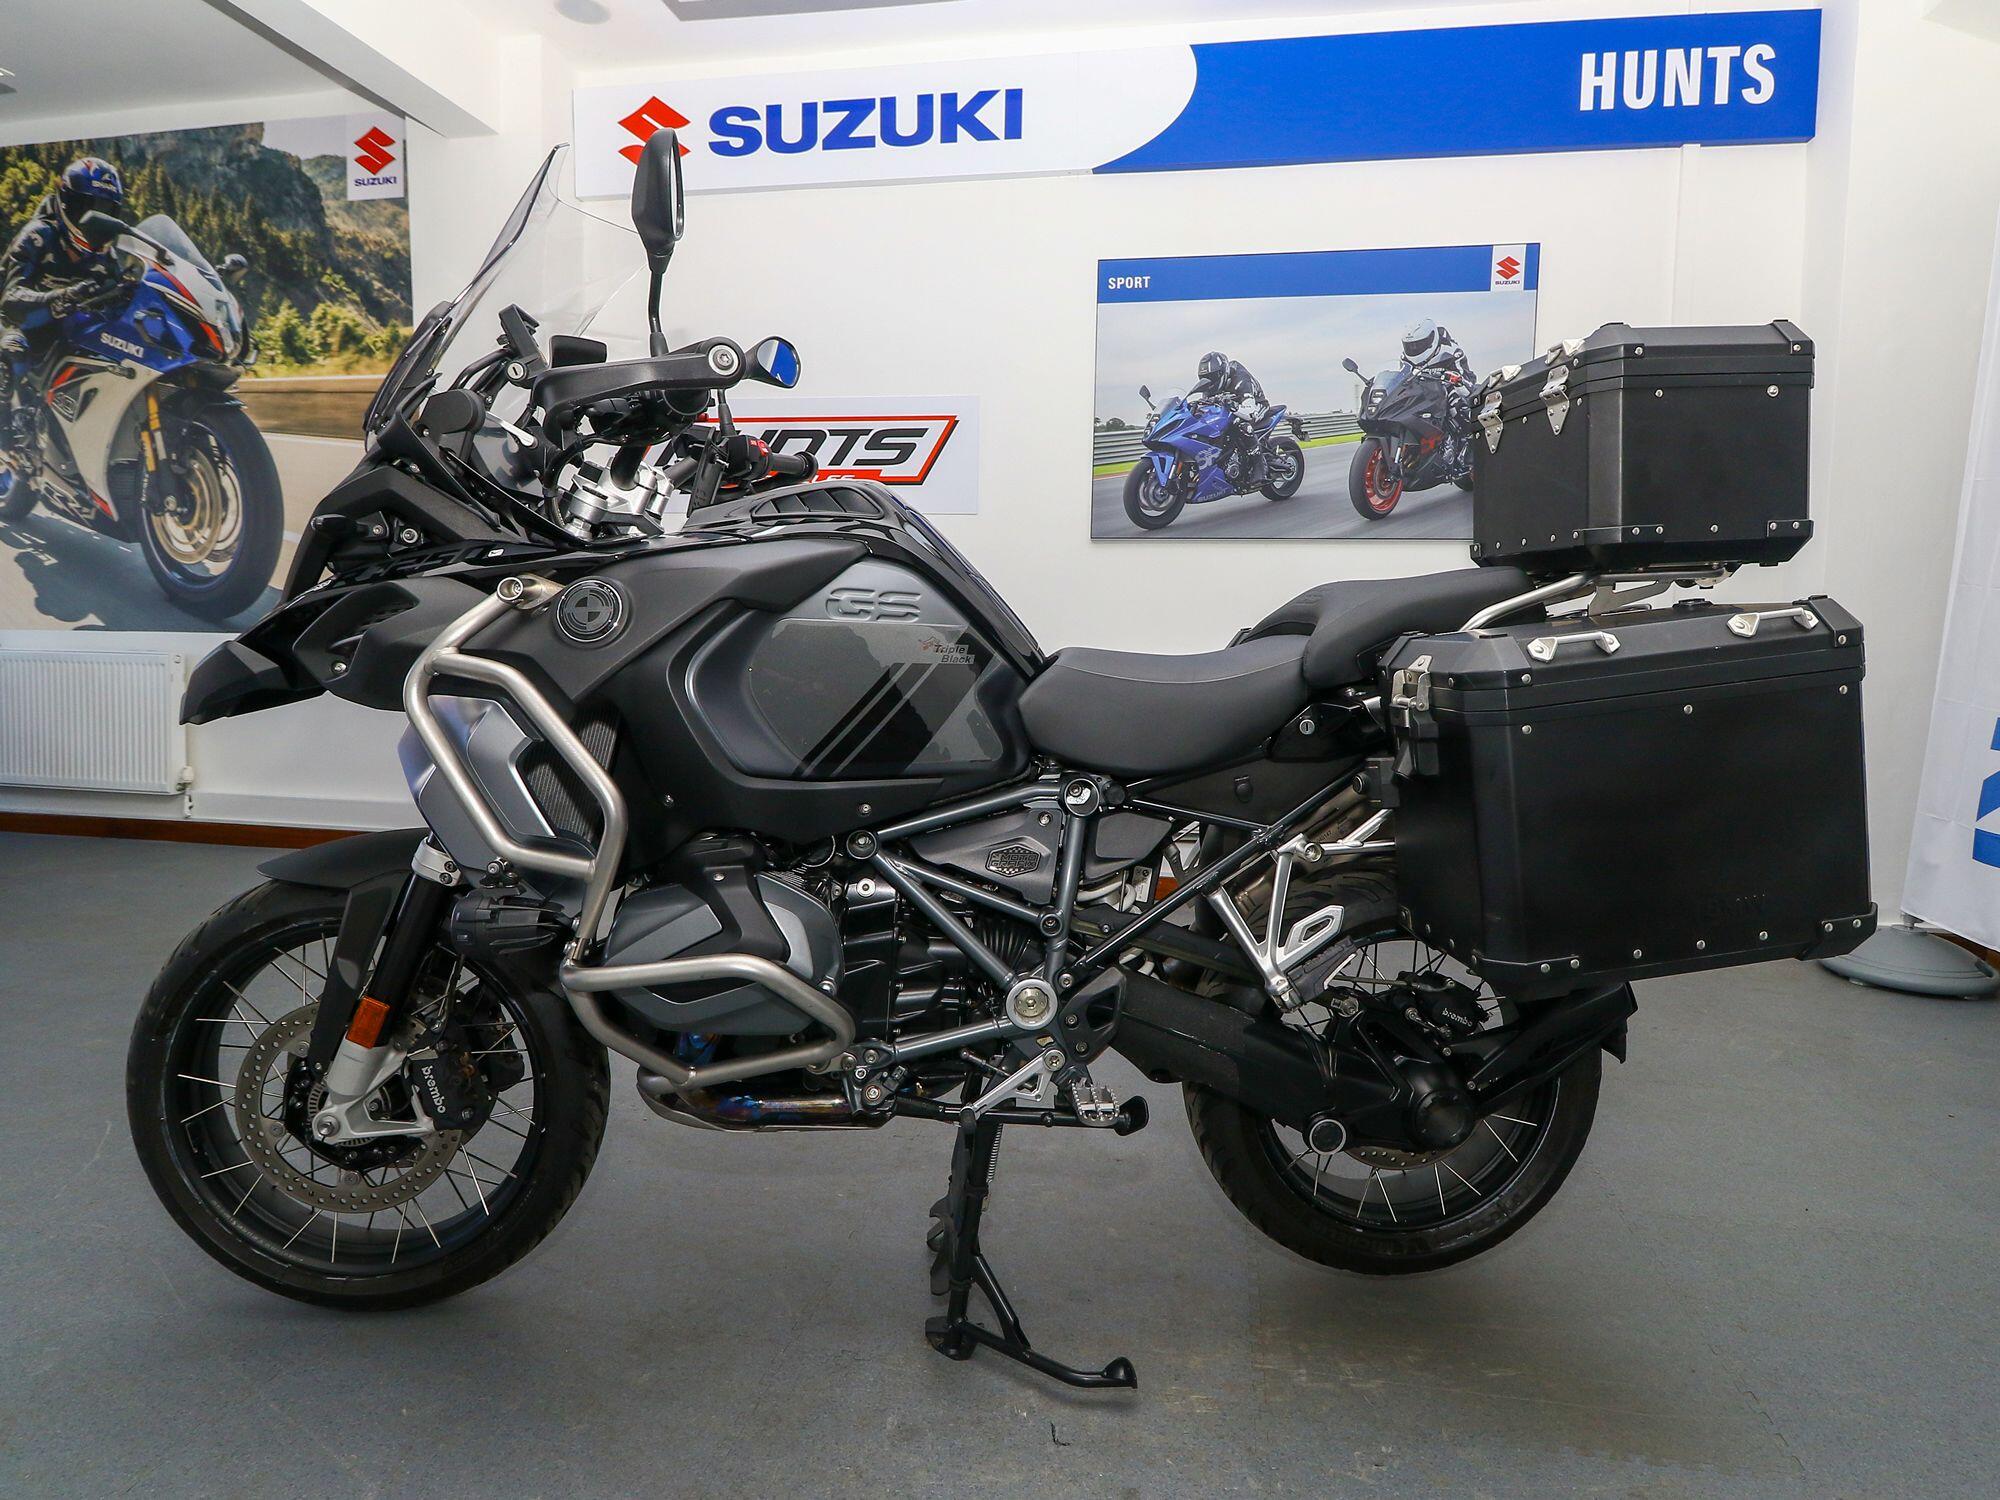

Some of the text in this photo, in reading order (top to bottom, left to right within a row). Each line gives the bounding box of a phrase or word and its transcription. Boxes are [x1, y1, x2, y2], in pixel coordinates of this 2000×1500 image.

[1579, 43, 1776, 111] HUNTS
[708, 88, 1023, 157] SUZUKI
[354, 176, 397, 187] SUZUKI
[1108, 276, 1151, 290] SPORT
[101, 332, 144, 359] SUZUKI
[825, 587, 922, 624] GS
[935, 644, 966, 655] Triple
[941, 654, 972, 664] Black
[1442, 1007, 1473, 1027] brembo
[421, 1065, 446, 1114] brembo
